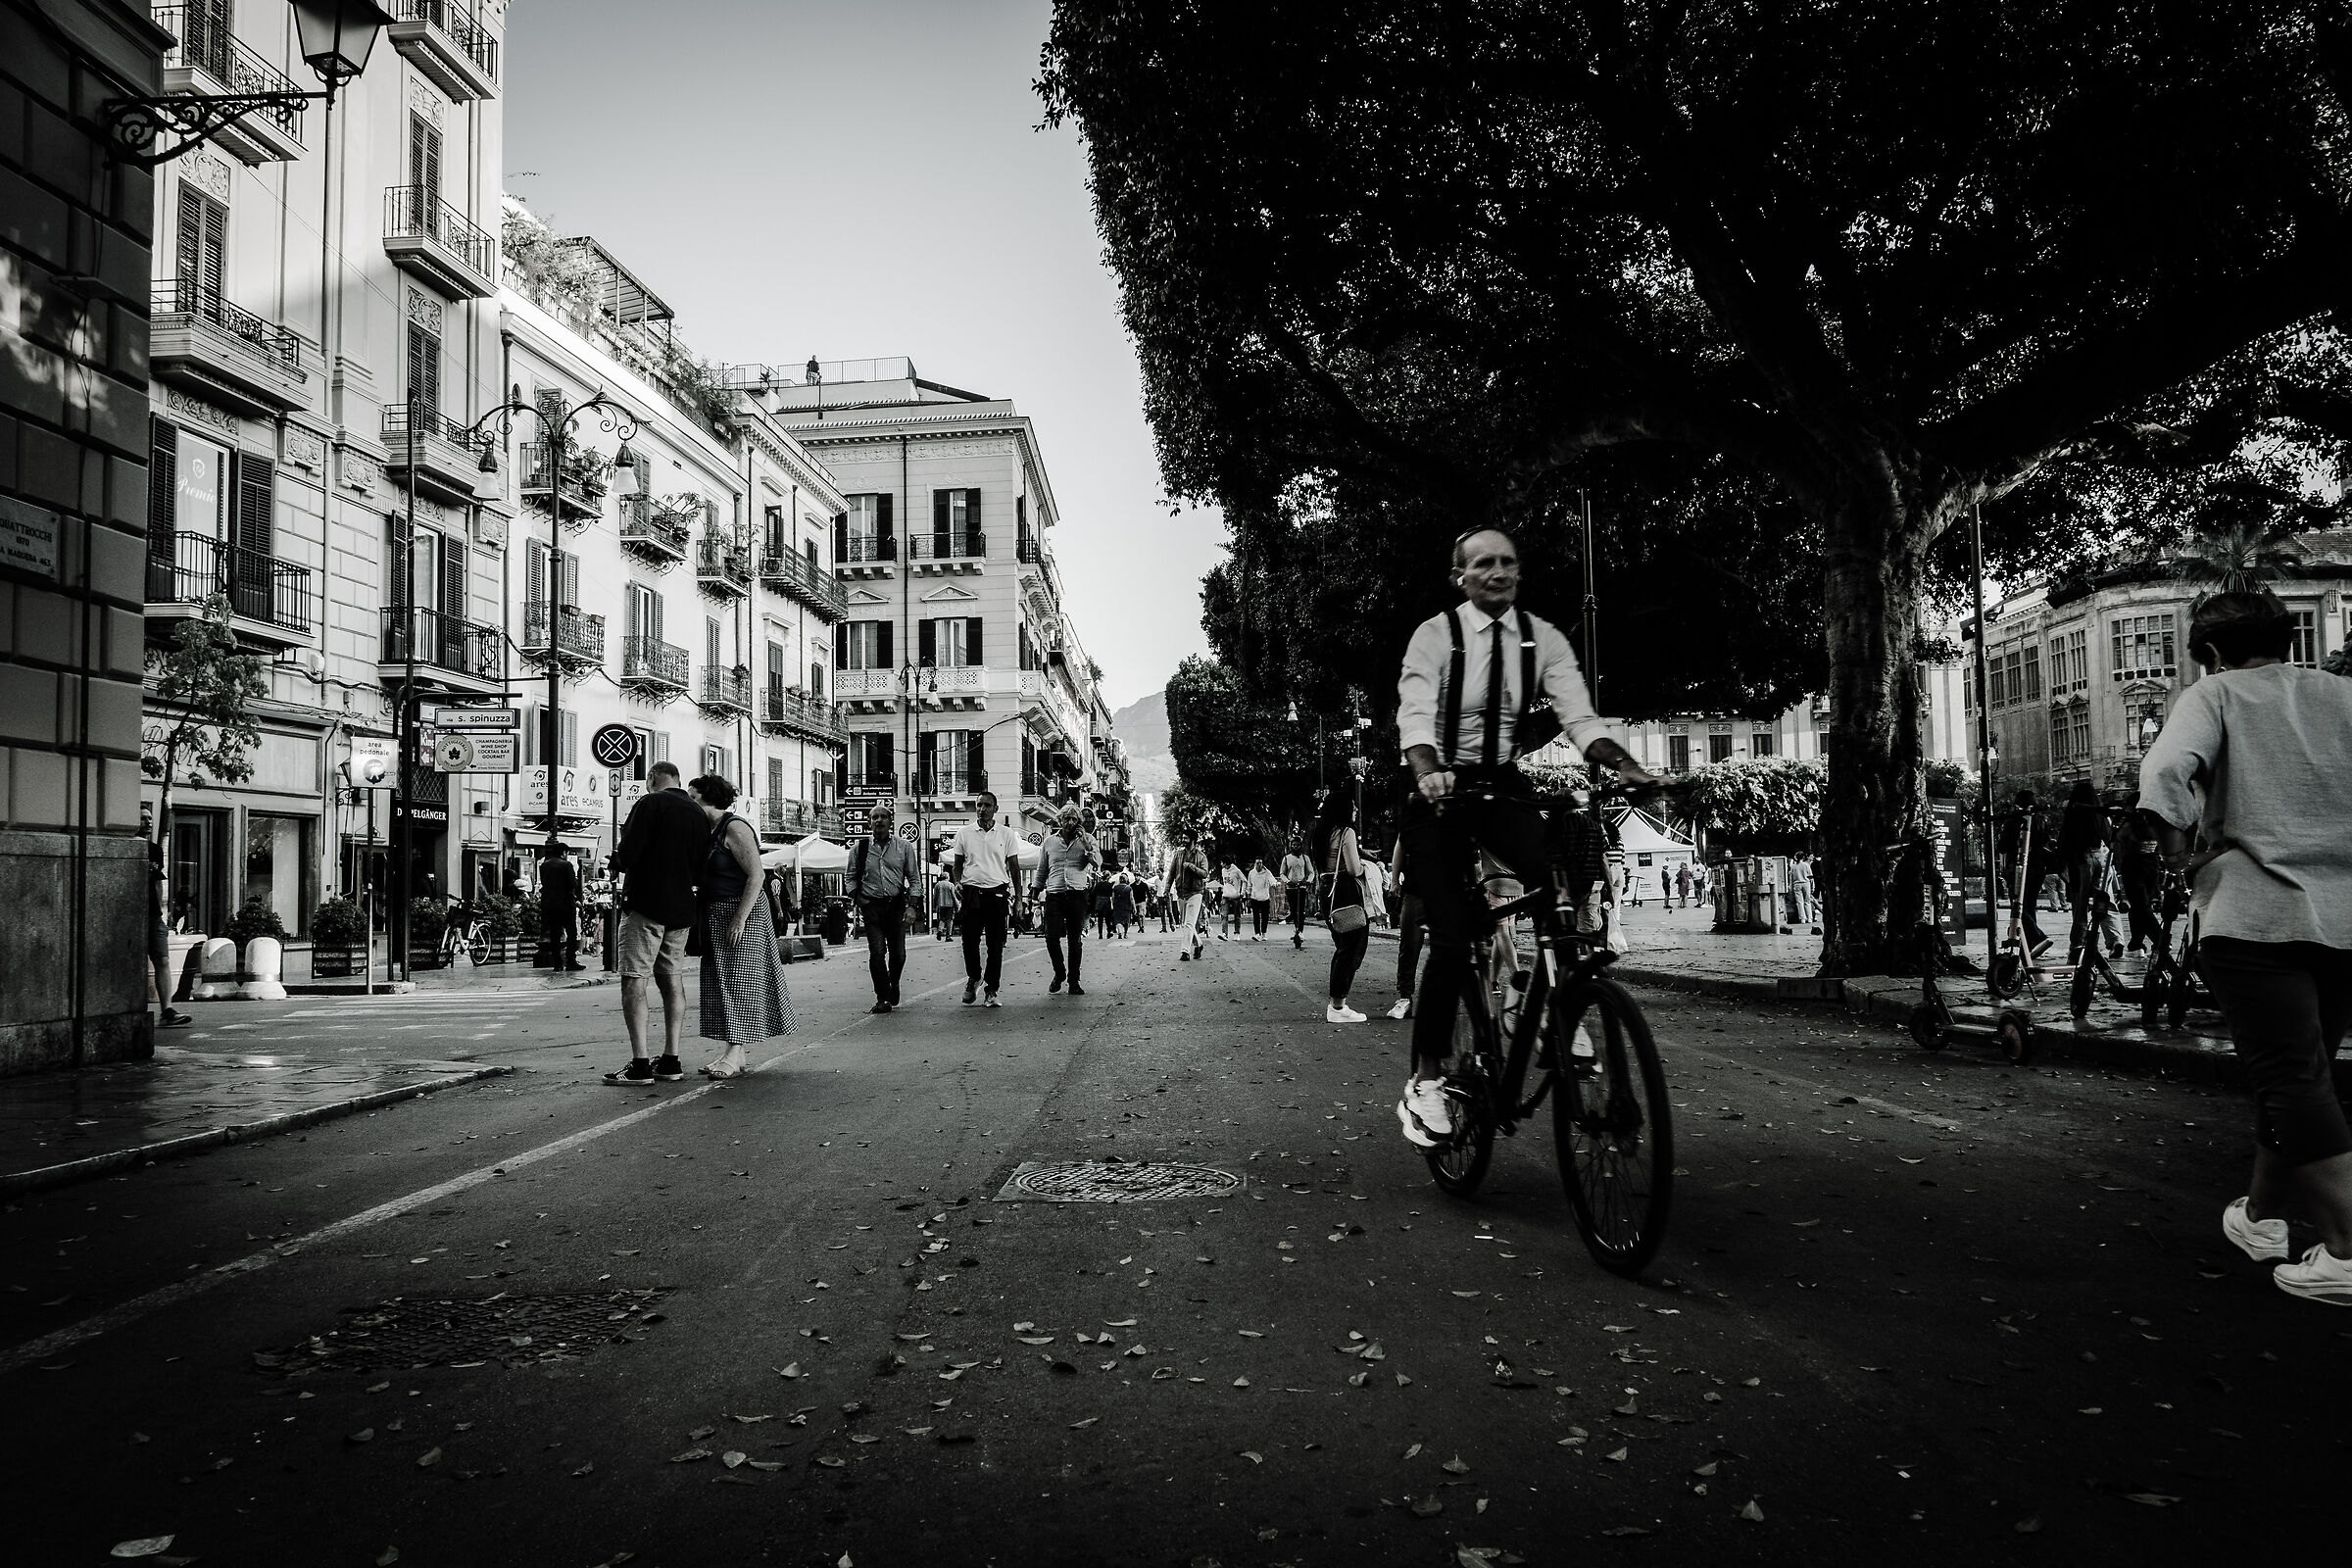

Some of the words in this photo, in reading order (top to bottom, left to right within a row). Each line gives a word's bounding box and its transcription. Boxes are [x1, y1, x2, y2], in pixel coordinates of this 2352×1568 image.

[469, 714, 511, 724] spinuzza
[561, 794, 578, 807] ares
[397, 808, 447, 821] DPELGÄNGER
